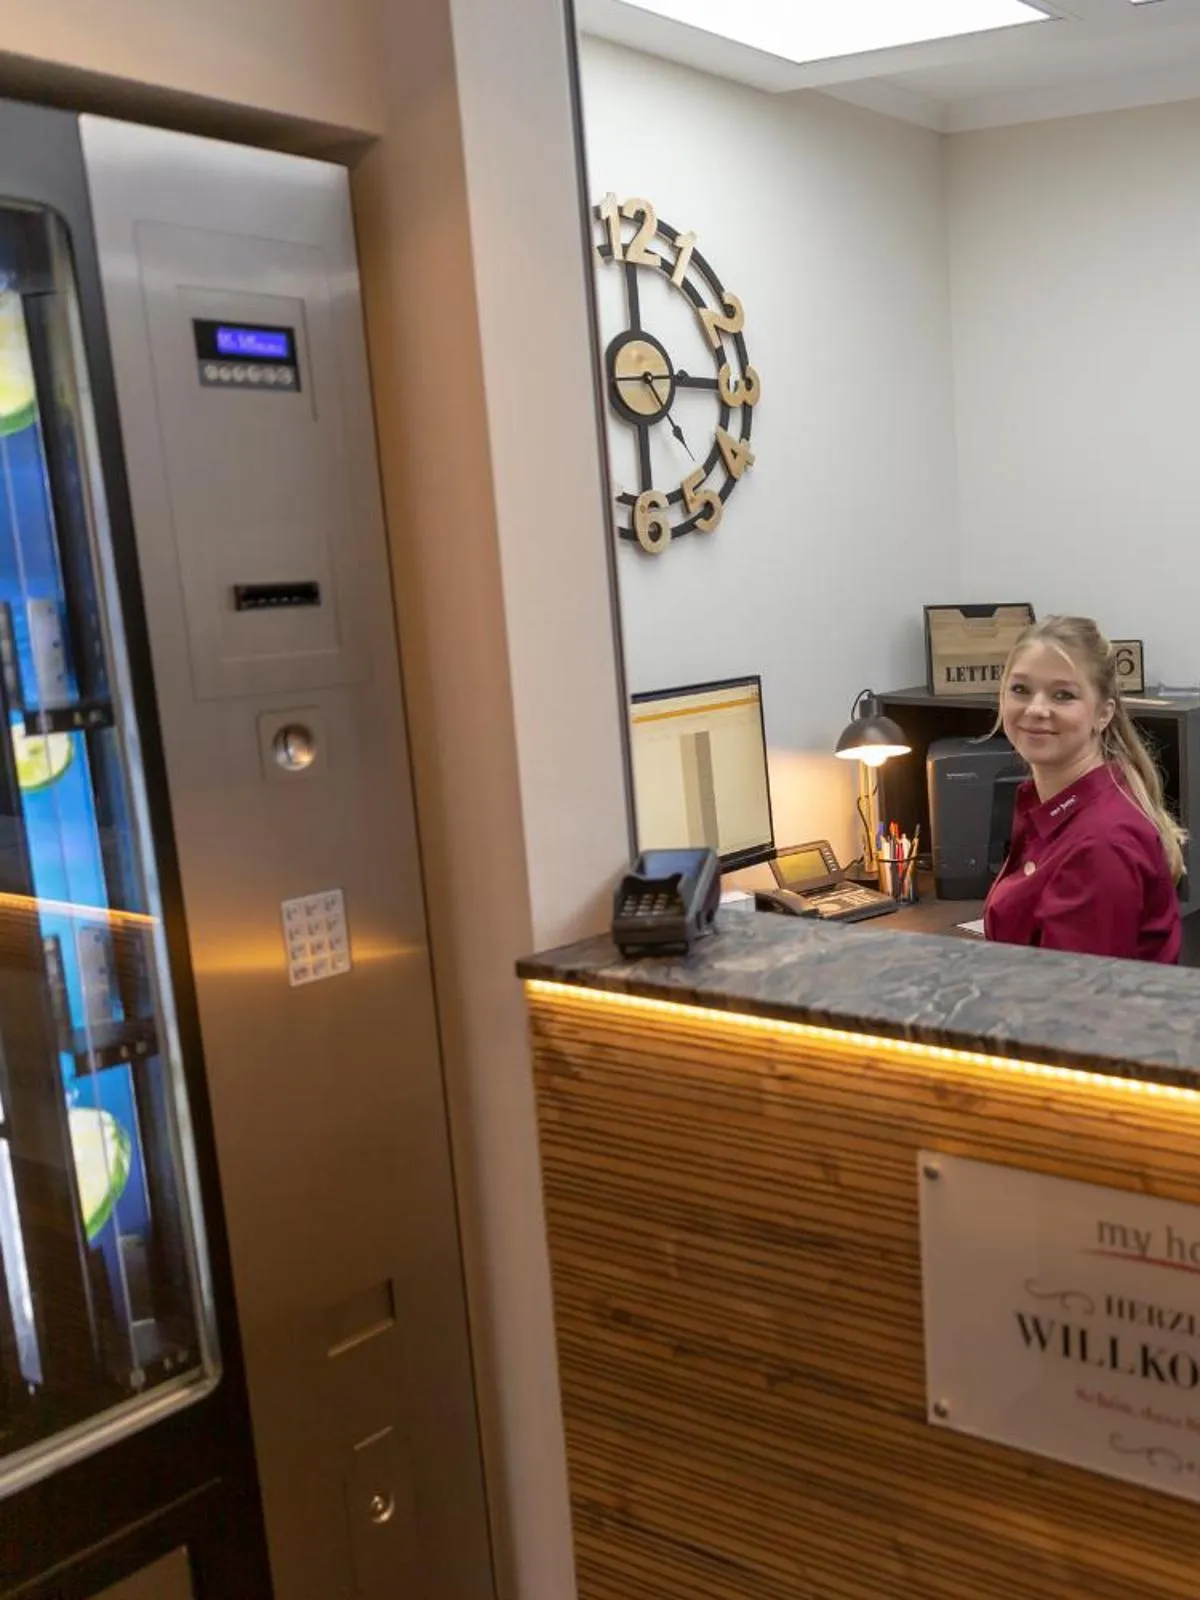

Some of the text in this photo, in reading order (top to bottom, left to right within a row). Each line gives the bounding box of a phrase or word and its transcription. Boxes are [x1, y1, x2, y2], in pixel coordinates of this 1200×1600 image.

[600, 191, 662, 268] 12
[670, 230, 697, 288] 1
[698, 291, 745, 350] 2
[718, 362, 761, 409] 3
[715, 424, 756, 480] 4
[632, 488, 672, 554] 6
[680, 466, 723, 534] 5
[945, 663, 1006, 683] LETTE
[1115, 648, 1135, 676] 6
[1096, 1219, 1152, 1260] my
